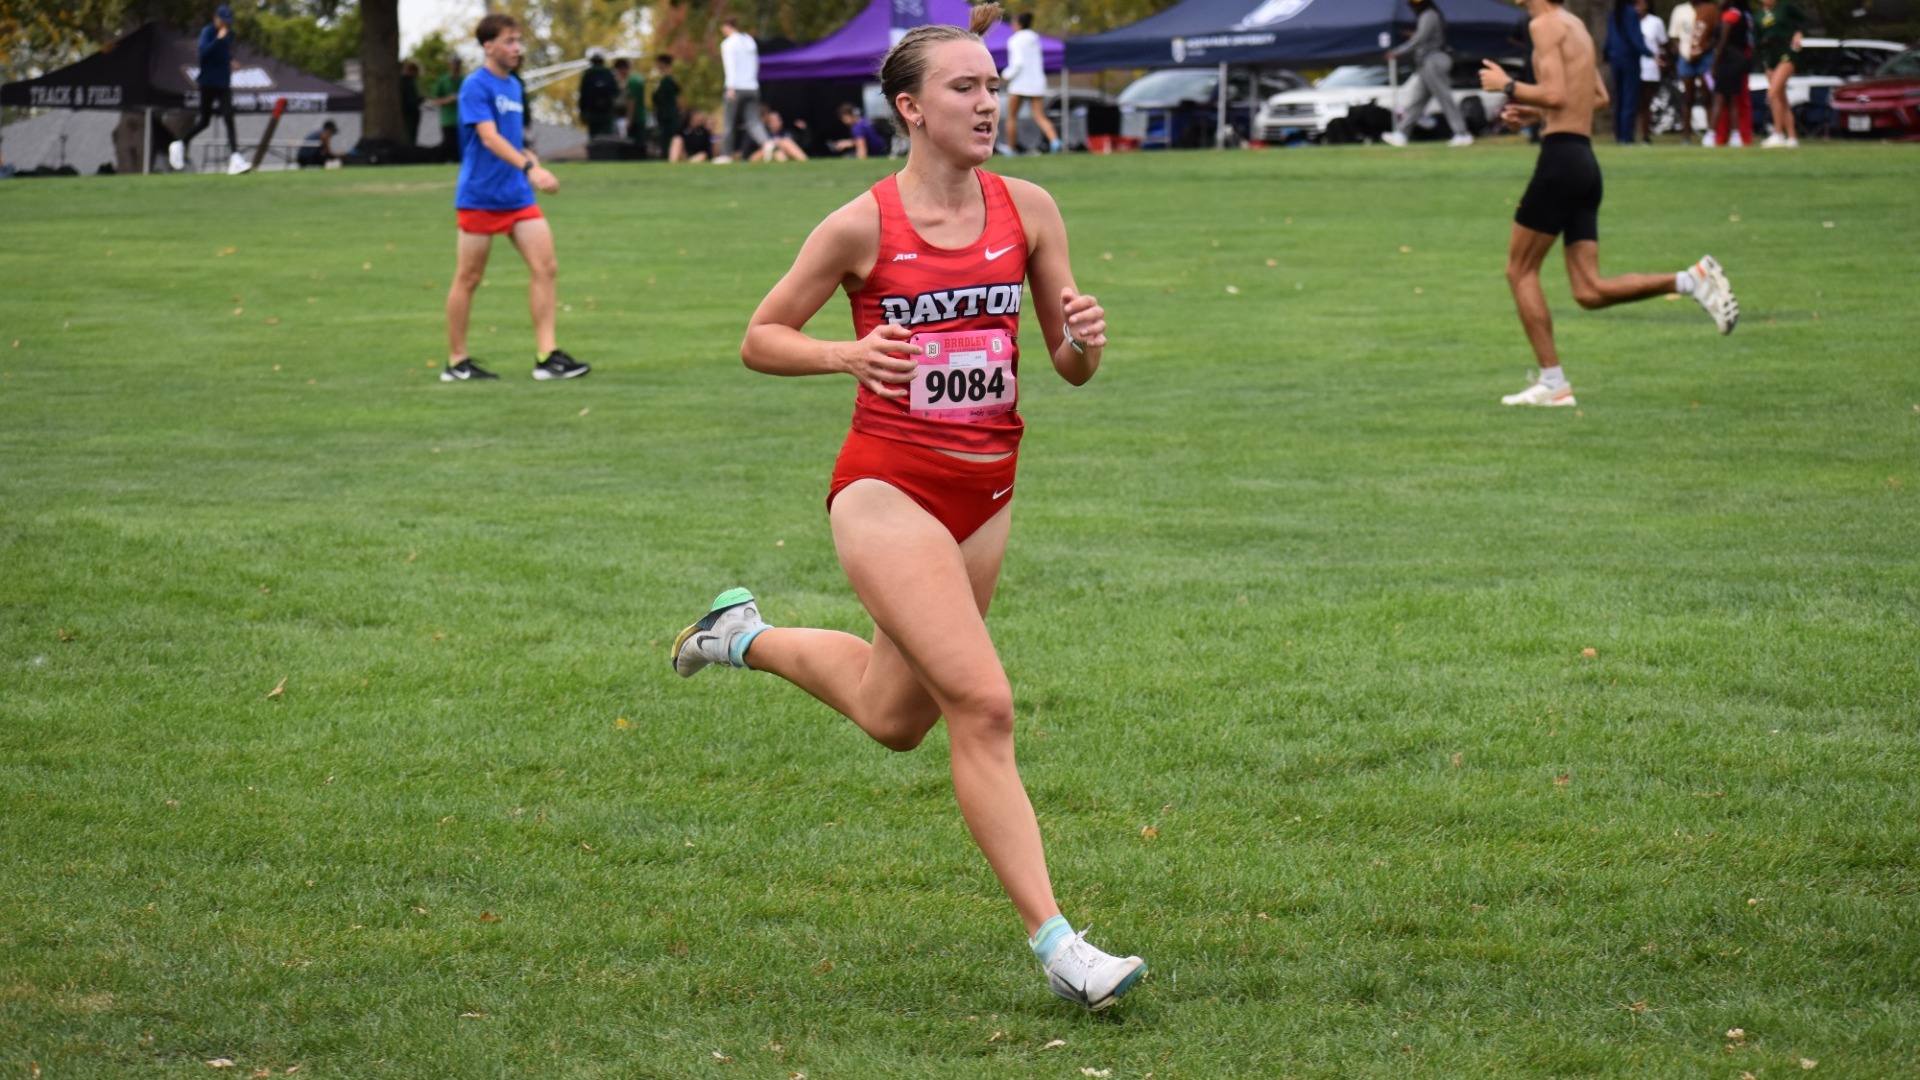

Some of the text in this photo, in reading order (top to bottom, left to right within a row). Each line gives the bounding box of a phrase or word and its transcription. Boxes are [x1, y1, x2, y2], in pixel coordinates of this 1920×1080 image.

[29, 85, 122, 105] TRACK & FIELD
[257, 91, 329, 112] UNIERSITY
[880, 283, 1022, 326] DAYTON
[944, 335, 987, 349] BRADLEY
[925, 367, 1005, 404] 9084
